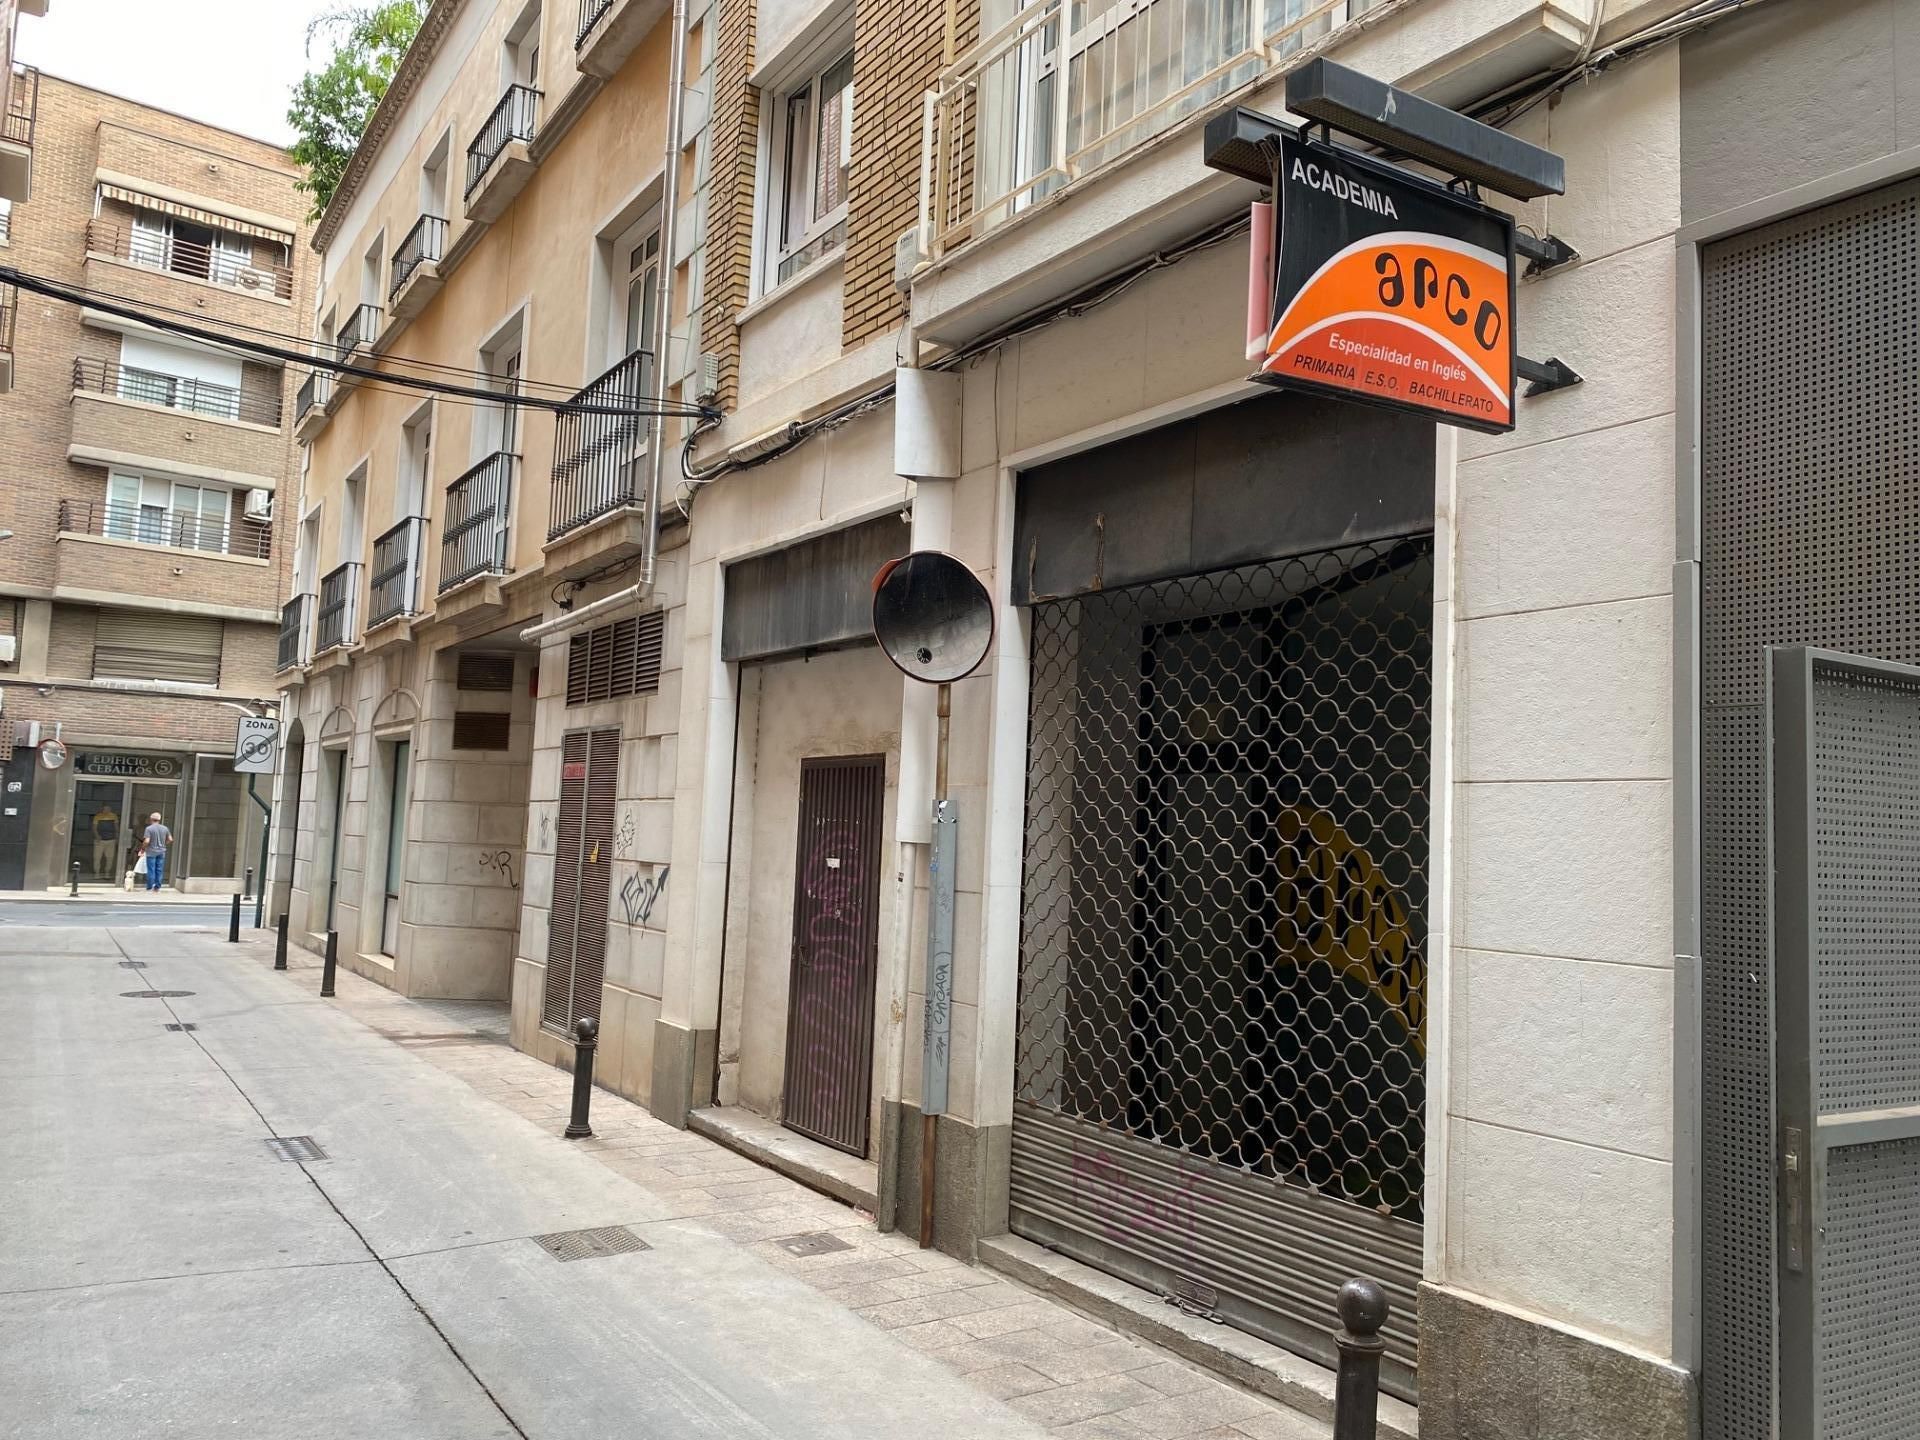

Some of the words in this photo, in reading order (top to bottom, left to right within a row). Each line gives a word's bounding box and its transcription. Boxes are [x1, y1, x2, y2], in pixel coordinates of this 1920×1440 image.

[1291, 157, 1399, 220] ACADEMIA
[1374, 252, 1501, 351] arco
[1328, 333, 1412, 367] Especialidad
[1414, 355, 1430, 371] en
[1431, 358, 1467, 382] Inglés
[1294, 354, 1355, 381] PRIMARIA
[1364, 370, 1399, 392] E.S.O.
[1408, 380, 1494, 414] BACHILLERATO
[245, 720, 274, 730] ZONA
[93, 754, 149, 767] EDIFICIO
[245, 741, 269, 756] 30
[87, 764, 152, 775] CEBALLOS
